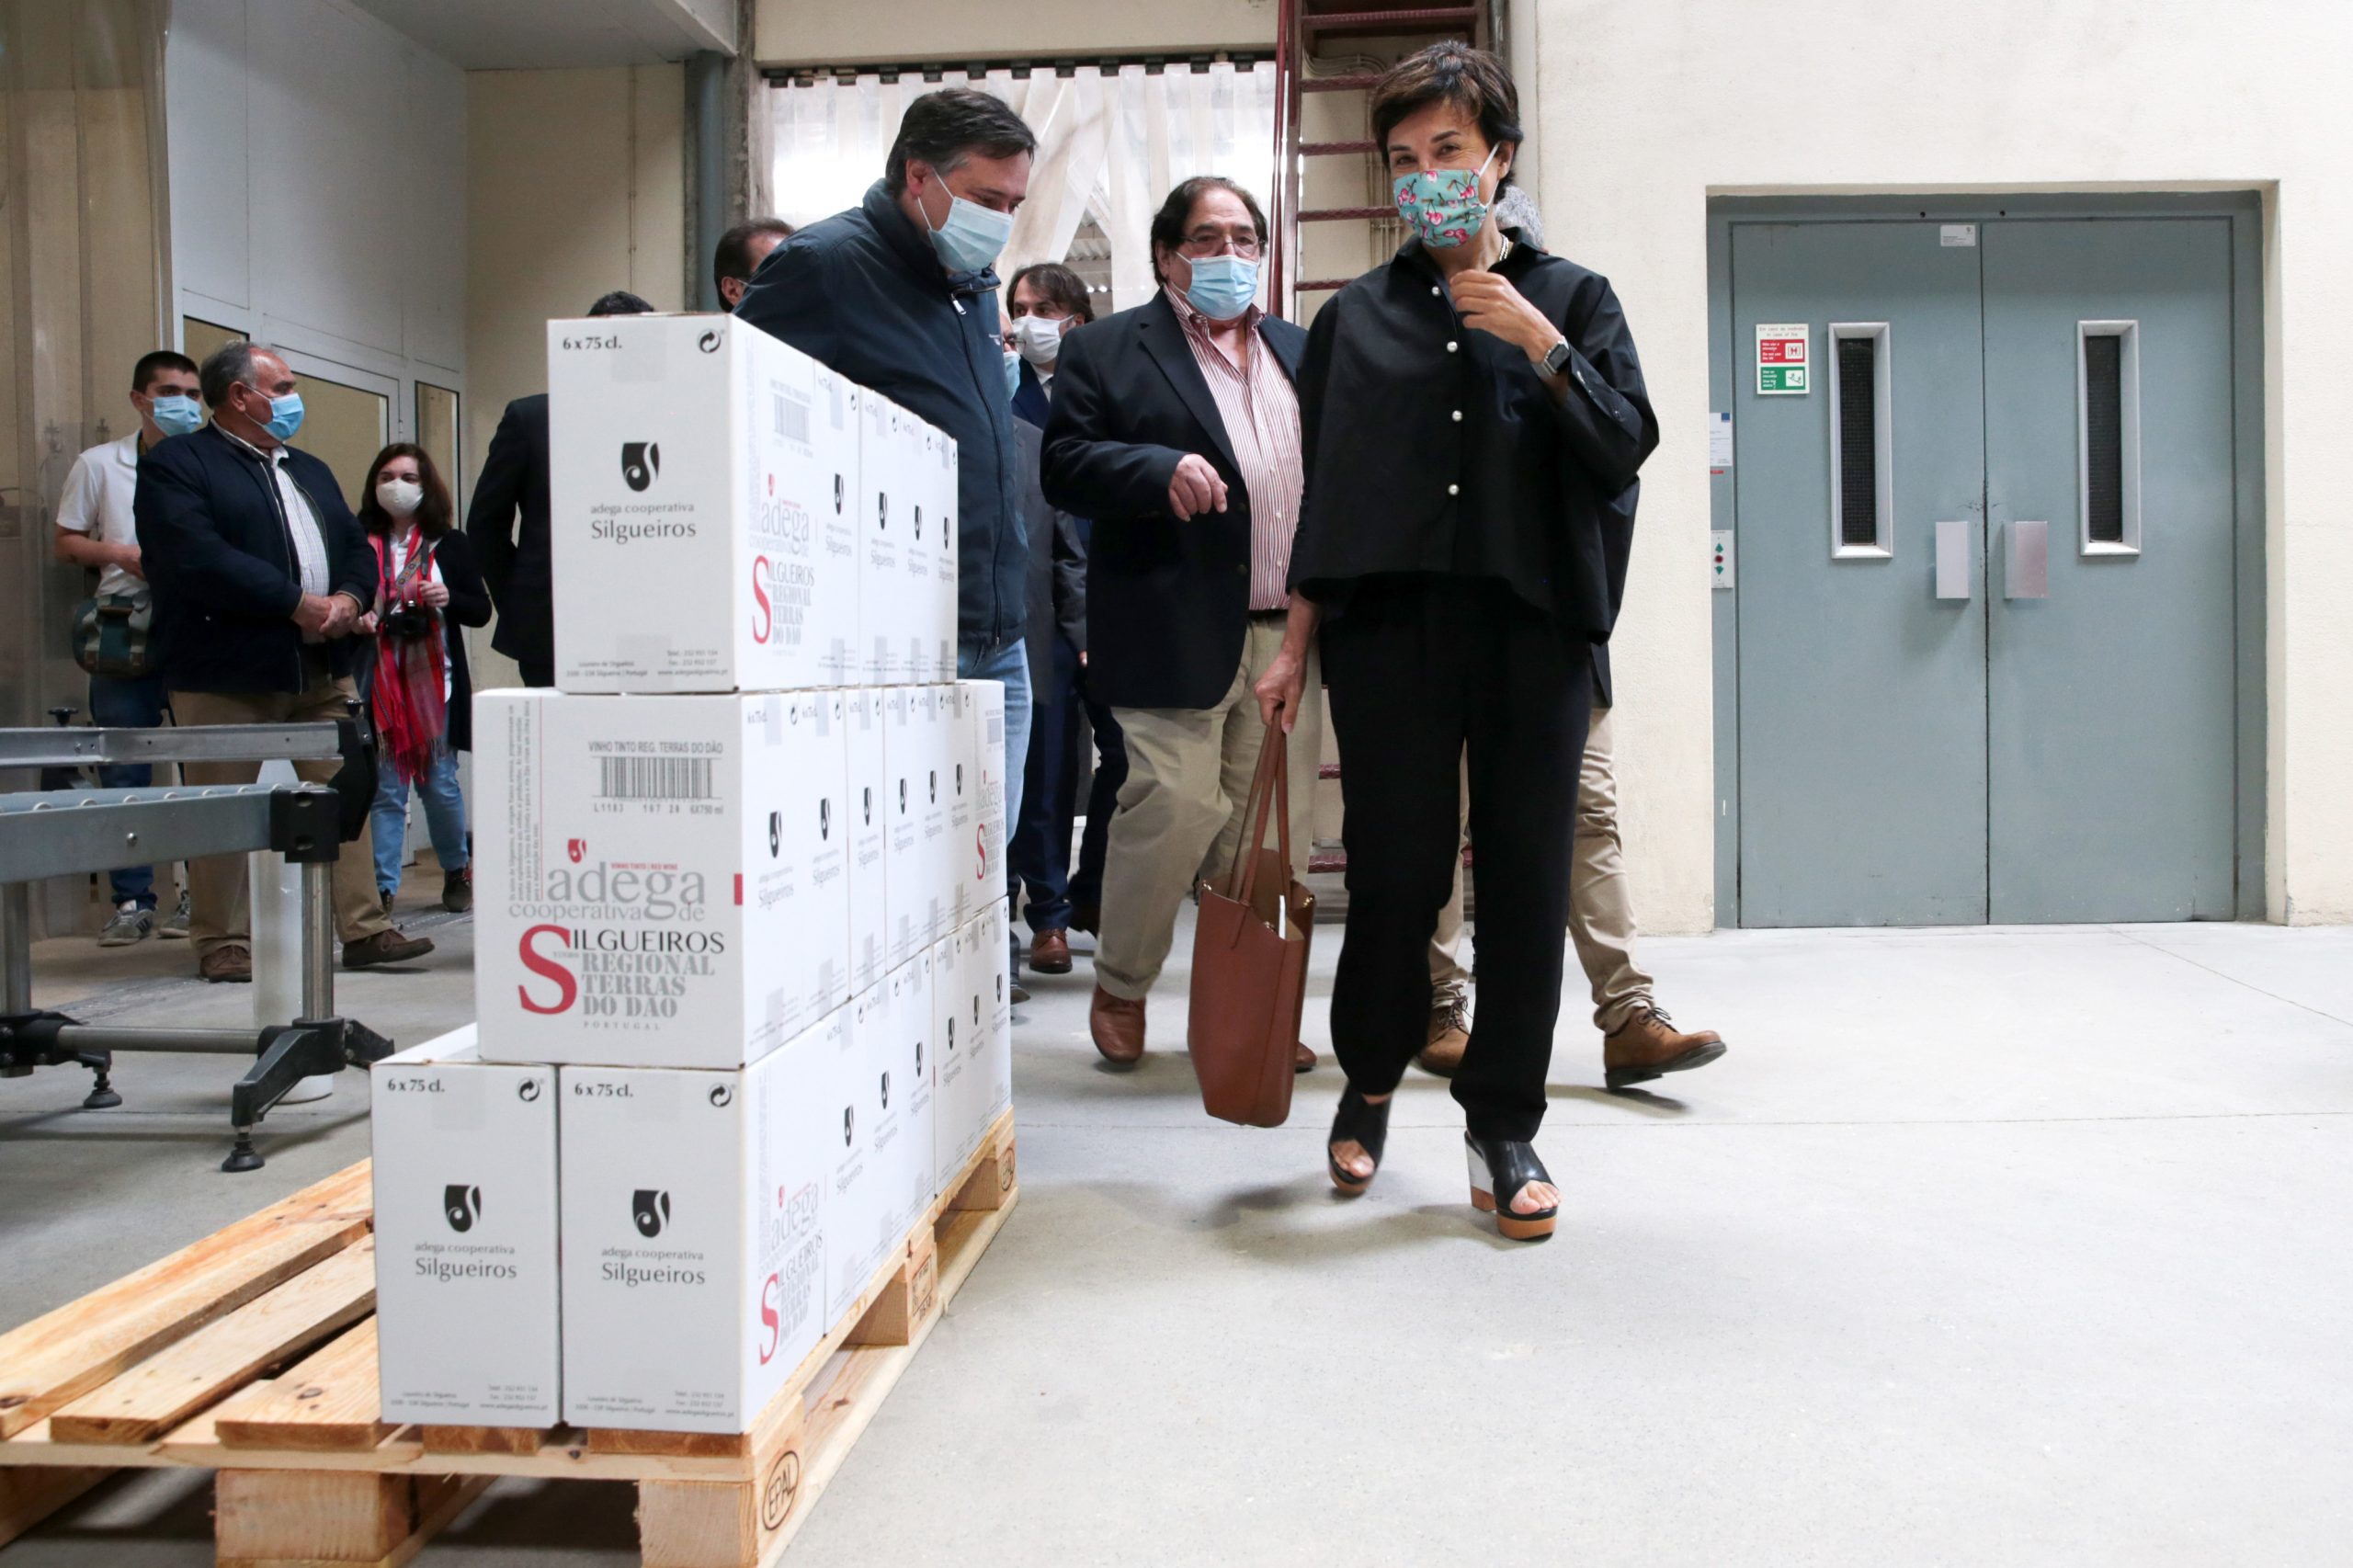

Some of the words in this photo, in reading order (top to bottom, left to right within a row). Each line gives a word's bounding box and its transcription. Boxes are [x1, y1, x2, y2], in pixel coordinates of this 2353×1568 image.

[563, 337, 571, 350] 6
[574, 339, 582, 349] x
[585, 336, 601, 349] 75
[605, 335, 622, 349] cl.
[591, 505, 621, 517] adega
[625, 503, 695, 515] cooperativa
[591, 519, 697, 545] Silgueiros
[761, 501, 810, 555] adega
[588, 741, 613, 752] VINHO
[614, 741, 636, 752] TINTO
[659, 742, 689, 754] TERRAS
[691, 743, 704, 754] DO
[705, 740, 723, 754] DÃO
[547, 861, 705, 920] adega
[508, 903, 642, 923] cooperativa
[678, 903, 705, 922] de
[582, 952, 715, 975] REGIONAL
[582, 973, 686, 996] TERRAS
[583, 995, 618, 1016] DO
[584, 1021, 661, 1030] PORTUGAL
[388, 1079, 396, 1091] 6
[399, 1082, 406, 1091] x
[410, 1079, 426, 1092] 75
[428, 1078, 446, 1093] cl.
[574, 1083, 583, 1096] 6
[586, 1085, 594, 1096] x
[597, 1084, 613, 1096] 75
[616, 1083, 633, 1097] cl.
[771, 1183, 819, 1251] adega
[415, 1242, 445, 1254] adega
[448, 1244, 516, 1256] cooperativa
[601, 1246, 632, 1258] adega
[635, 1247, 704, 1261] cooperativa
[415, 1257, 517, 1282] Silgueiros
[602, 1262, 706, 1287] Silgueiros
[768, 1463, 796, 1521] EPAL
